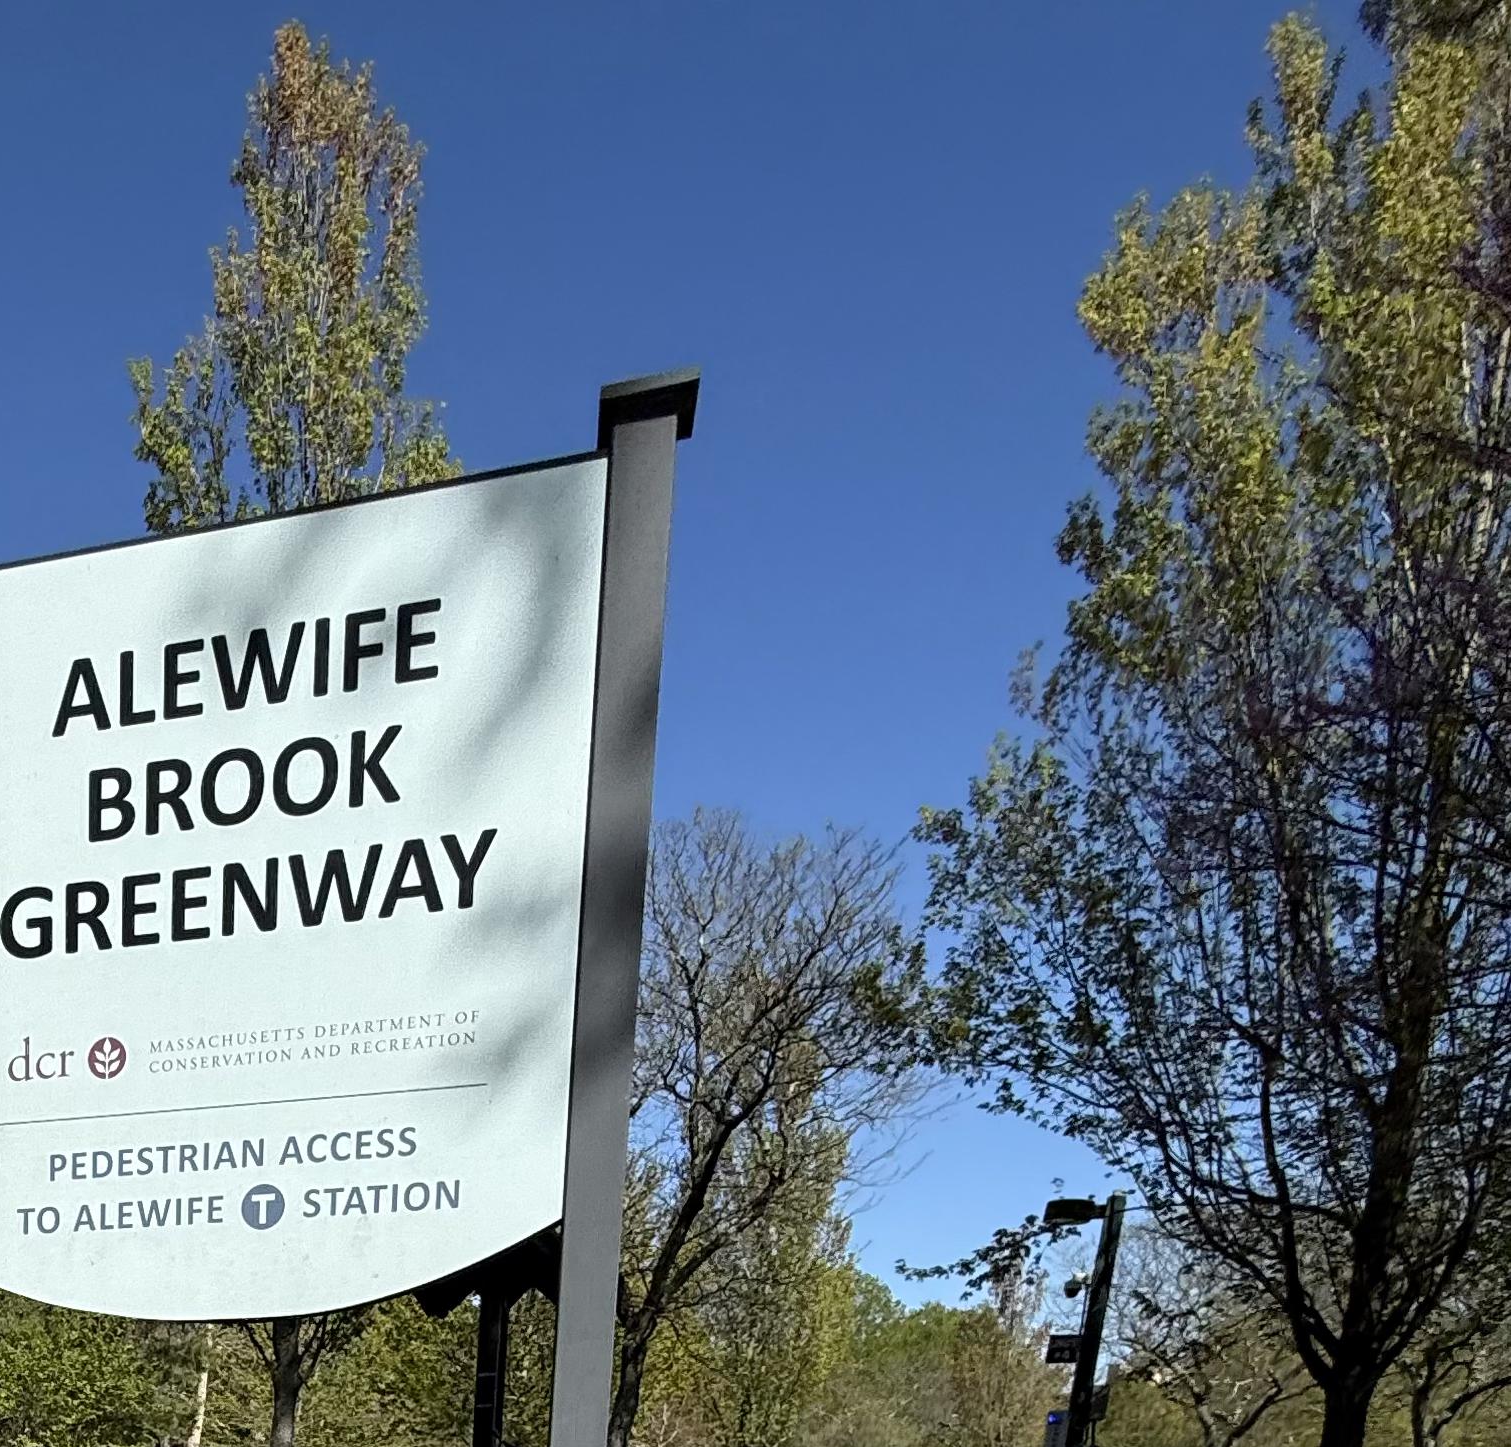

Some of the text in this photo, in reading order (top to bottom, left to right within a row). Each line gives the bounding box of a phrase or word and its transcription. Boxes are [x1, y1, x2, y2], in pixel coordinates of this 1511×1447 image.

[52, 598, 441, 737] ALEWIFE
[89, 725, 402, 842] BROOK
[0, 828, 497, 959] GREENWAY
[149, 1010, 481, 1053] MASSACHUSETTS DEPARTMENT OF
[149, 1031, 477, 1074] CONSERVATION AND RECREATION
[7, 1037, 74, 1082] dcr
[49, 1126, 417, 1181] PEDESTRIAN ACCESS
[17, 1179, 461, 1235] TO ALEWIFE T STATION
